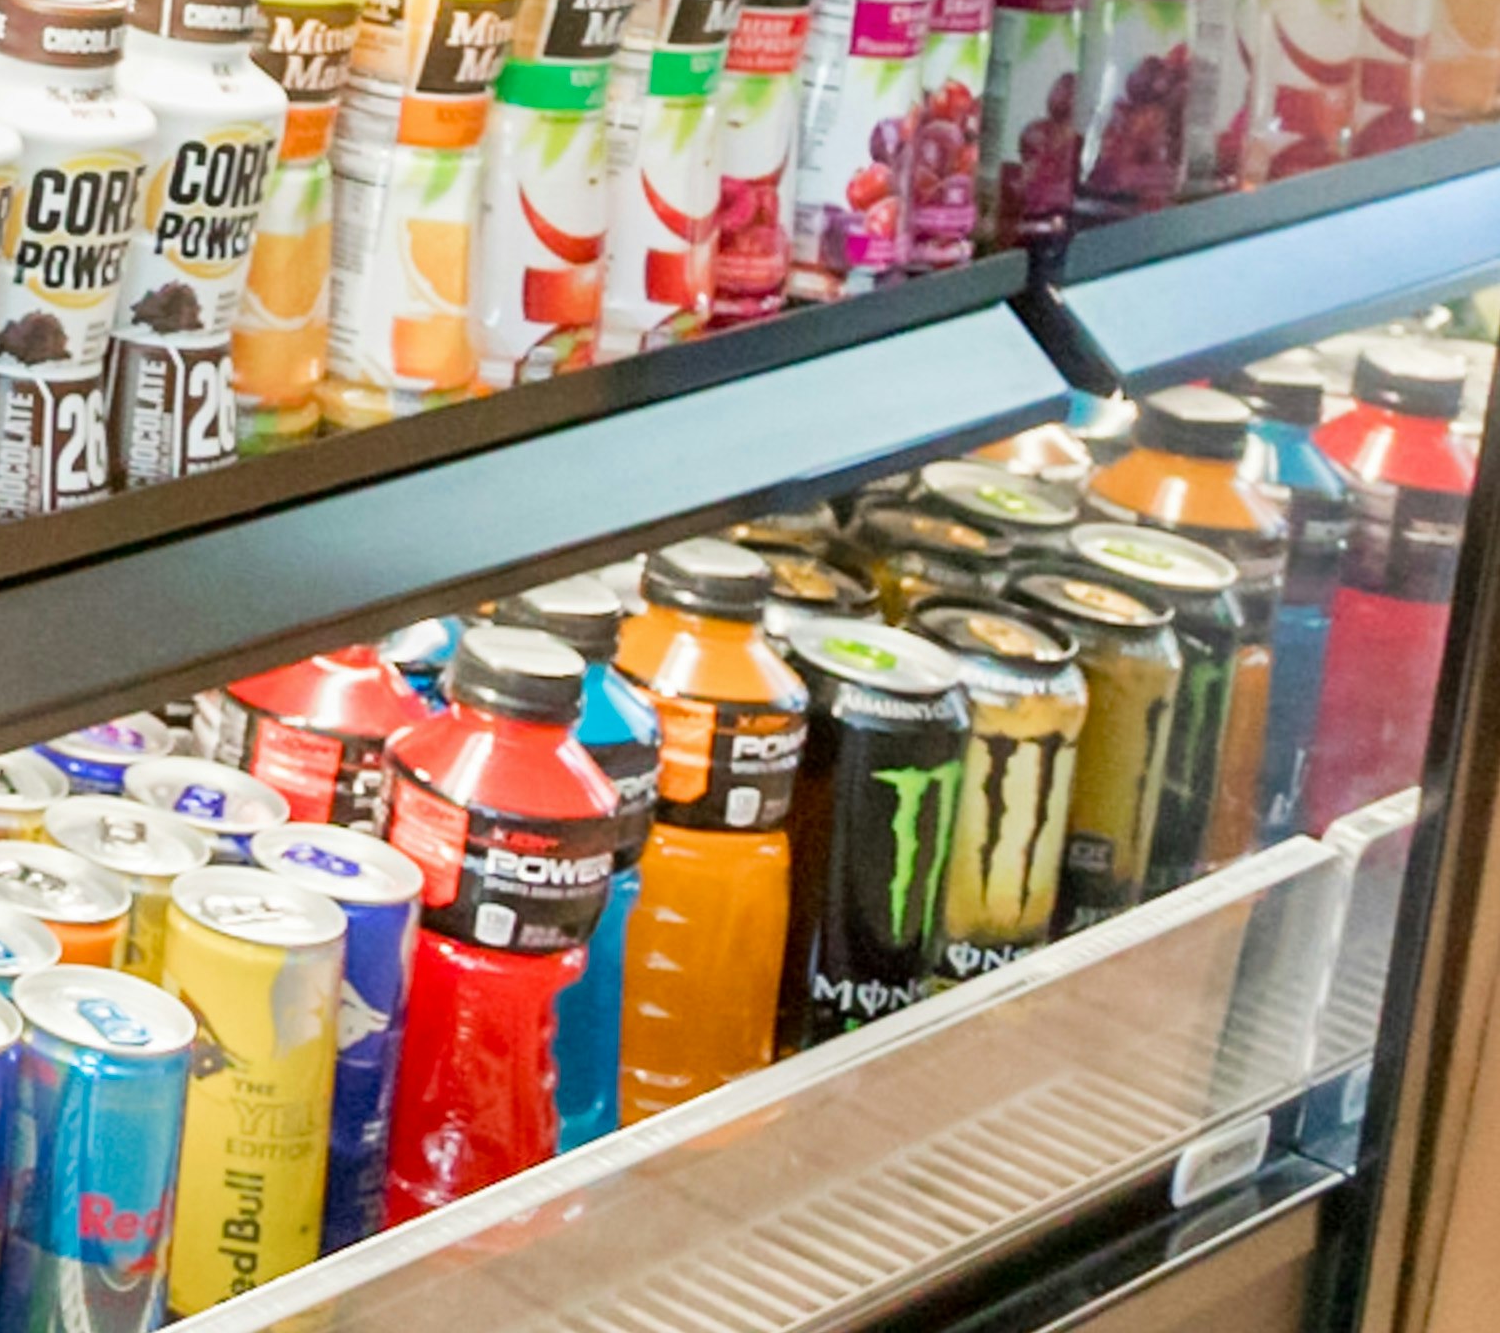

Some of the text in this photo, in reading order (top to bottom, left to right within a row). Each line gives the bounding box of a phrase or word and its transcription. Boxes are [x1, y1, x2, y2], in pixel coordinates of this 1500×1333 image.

[25, 163, 148, 235] CORE
[168, 139, 276, 207] CORE
[56, 388, 109, 491] 26
[187, 355, 238, 458] 26
